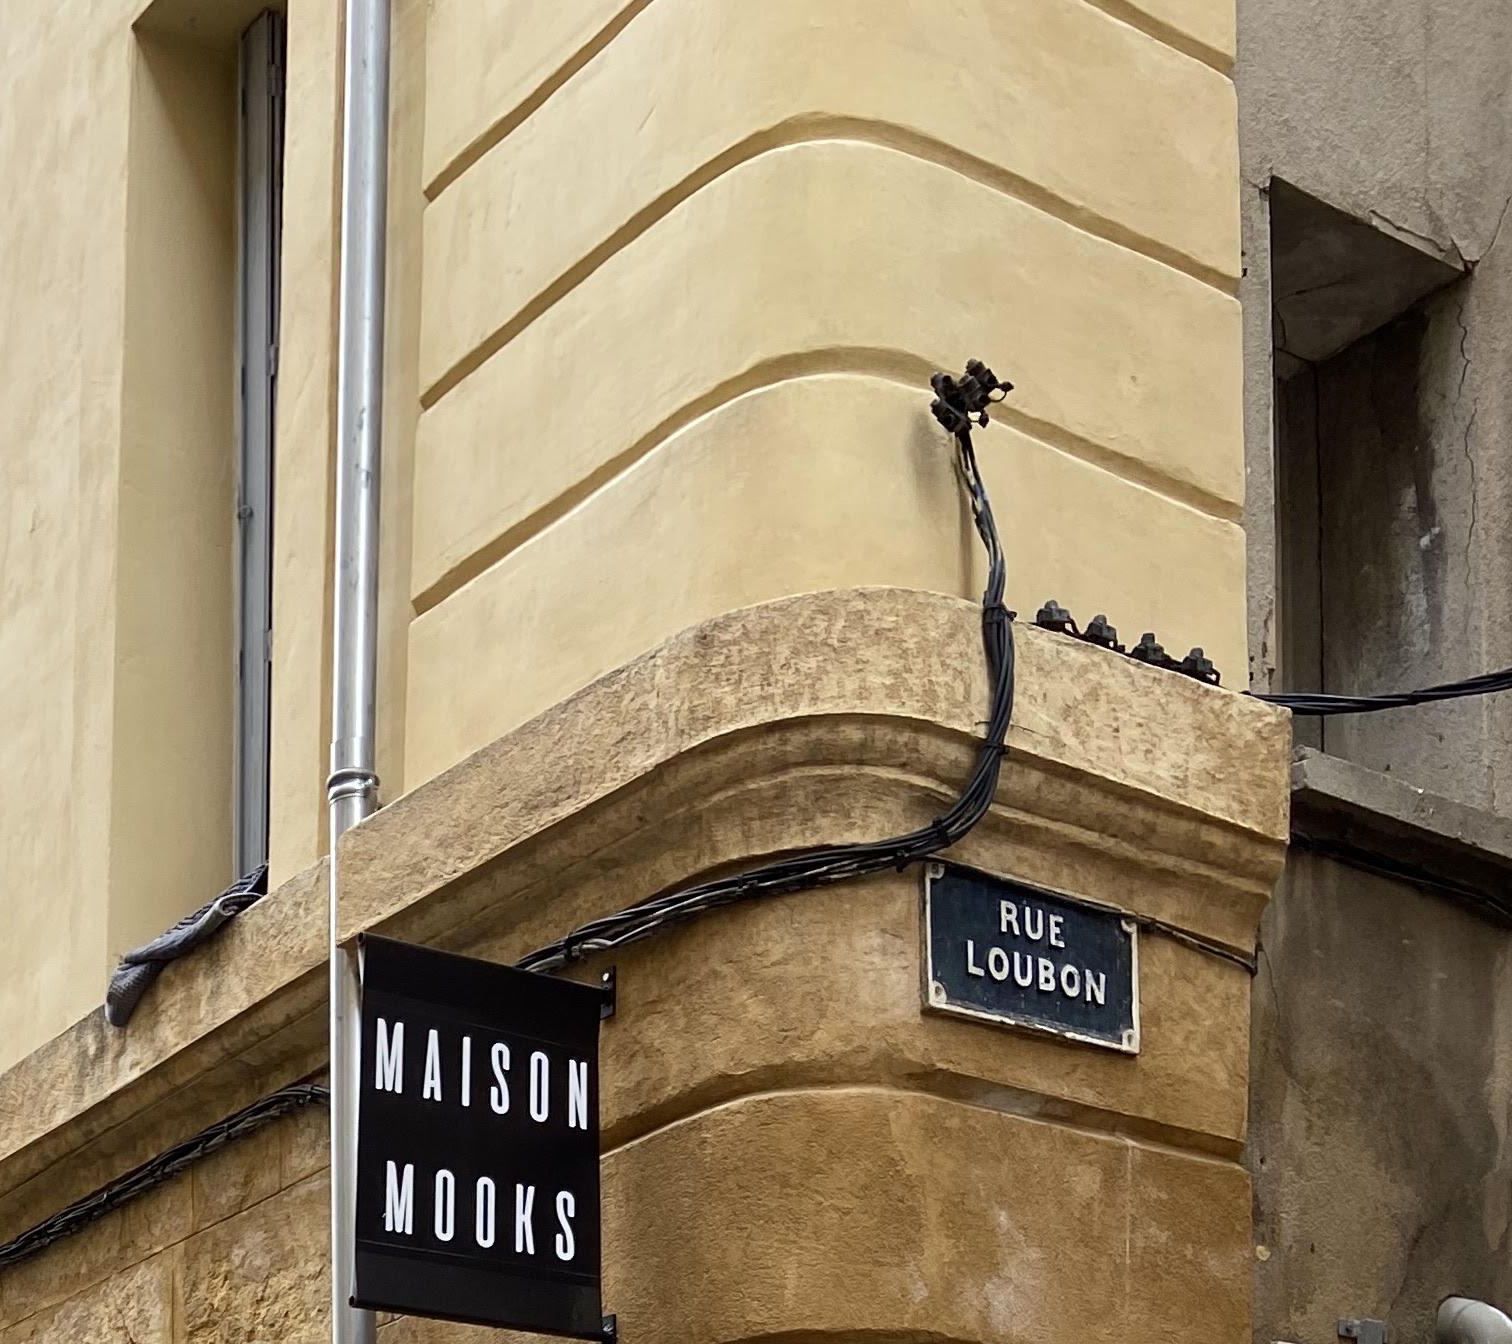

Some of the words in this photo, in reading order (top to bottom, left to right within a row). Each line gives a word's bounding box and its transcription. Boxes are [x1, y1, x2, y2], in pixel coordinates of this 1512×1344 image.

[1000, 900, 1065, 948] RUE
[966, 939, 1106, 1005] LOUBON
[375, 1017, 588, 1130] MAISON
[385, 1160, 575, 1261] MOOKS
